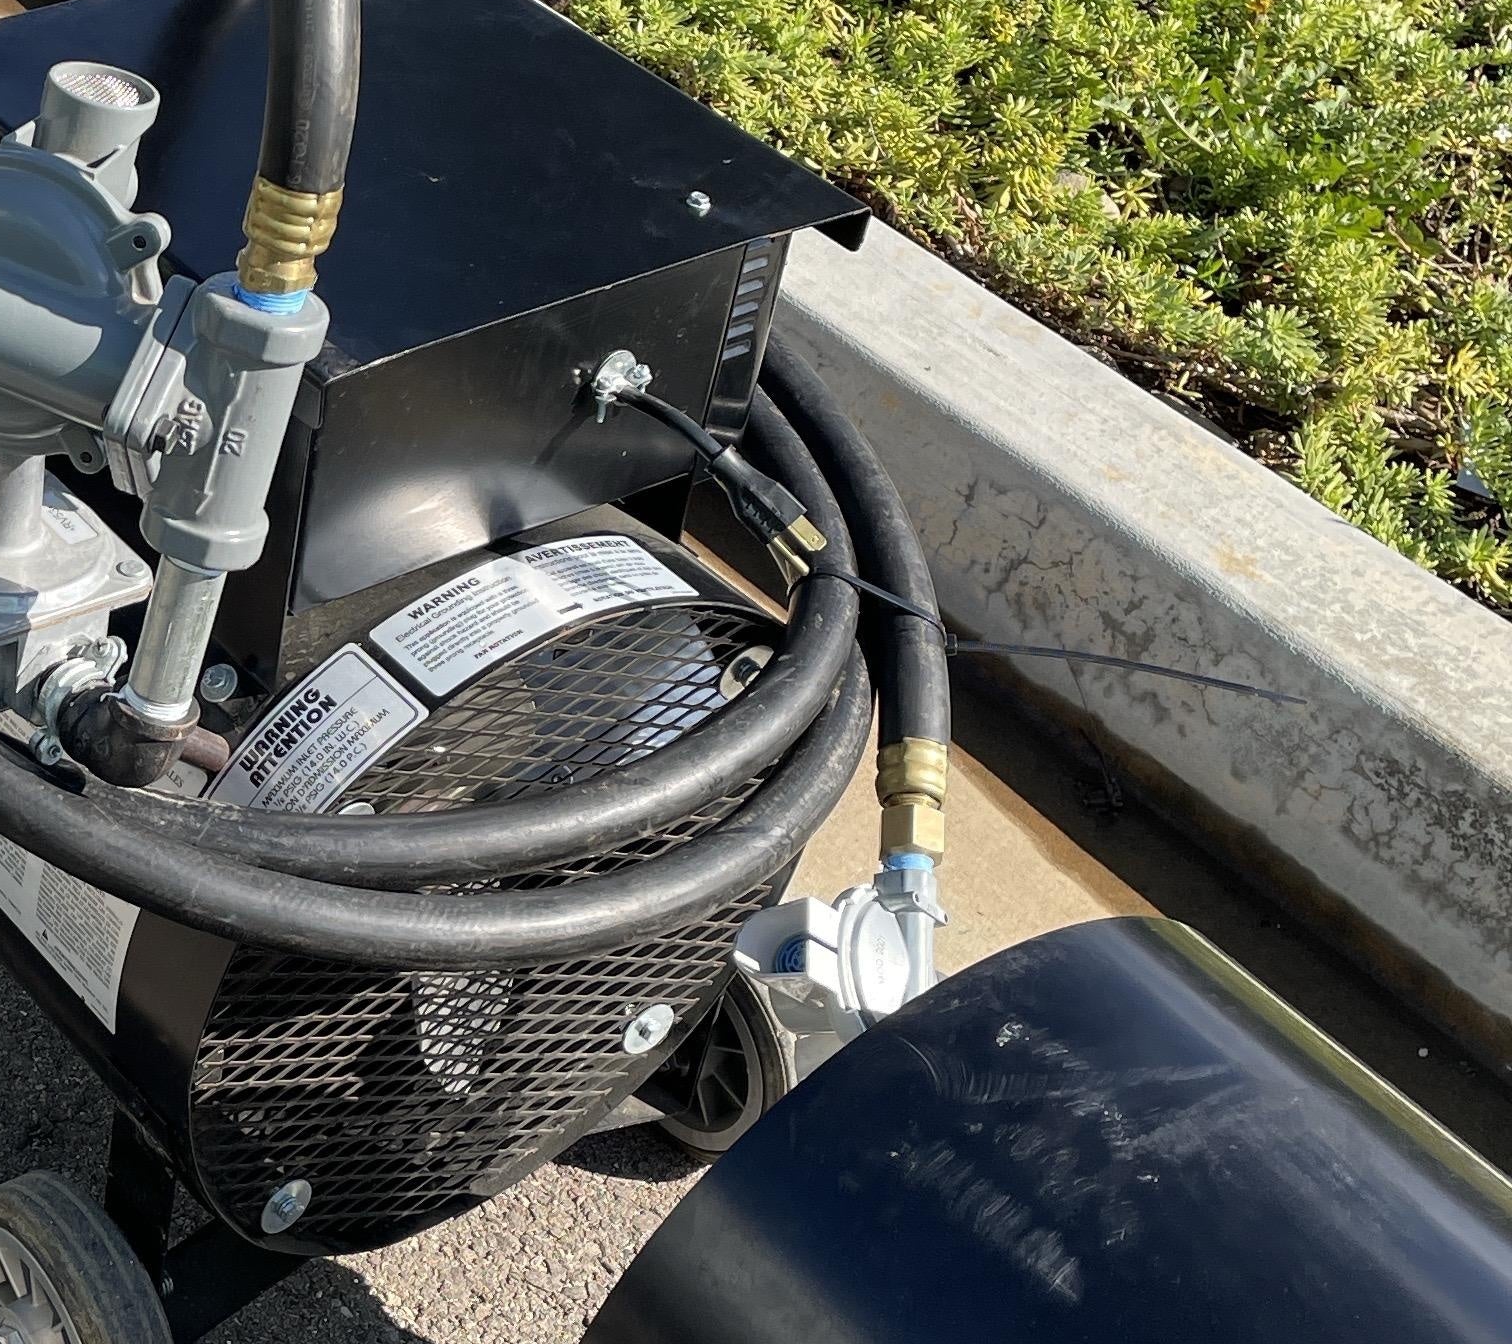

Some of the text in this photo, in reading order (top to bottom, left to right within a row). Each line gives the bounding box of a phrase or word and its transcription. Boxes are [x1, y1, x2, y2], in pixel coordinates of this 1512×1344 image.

[524, 540, 633, 564] AVERTISSEMENT
[395, 617, 431, 643] Electrical
[431, 596, 473, 619] Grounding
[408, 577, 481, 620] WARNING
[238, 687, 321, 772] WARNING
[249, 694, 338, 789] ATTENTION
[262, 707, 360, 808] MAXIMUM INLET PRESSURE
[283, 775, 303, 799] PSIG
[305, 782, 325, 805] PSIG
